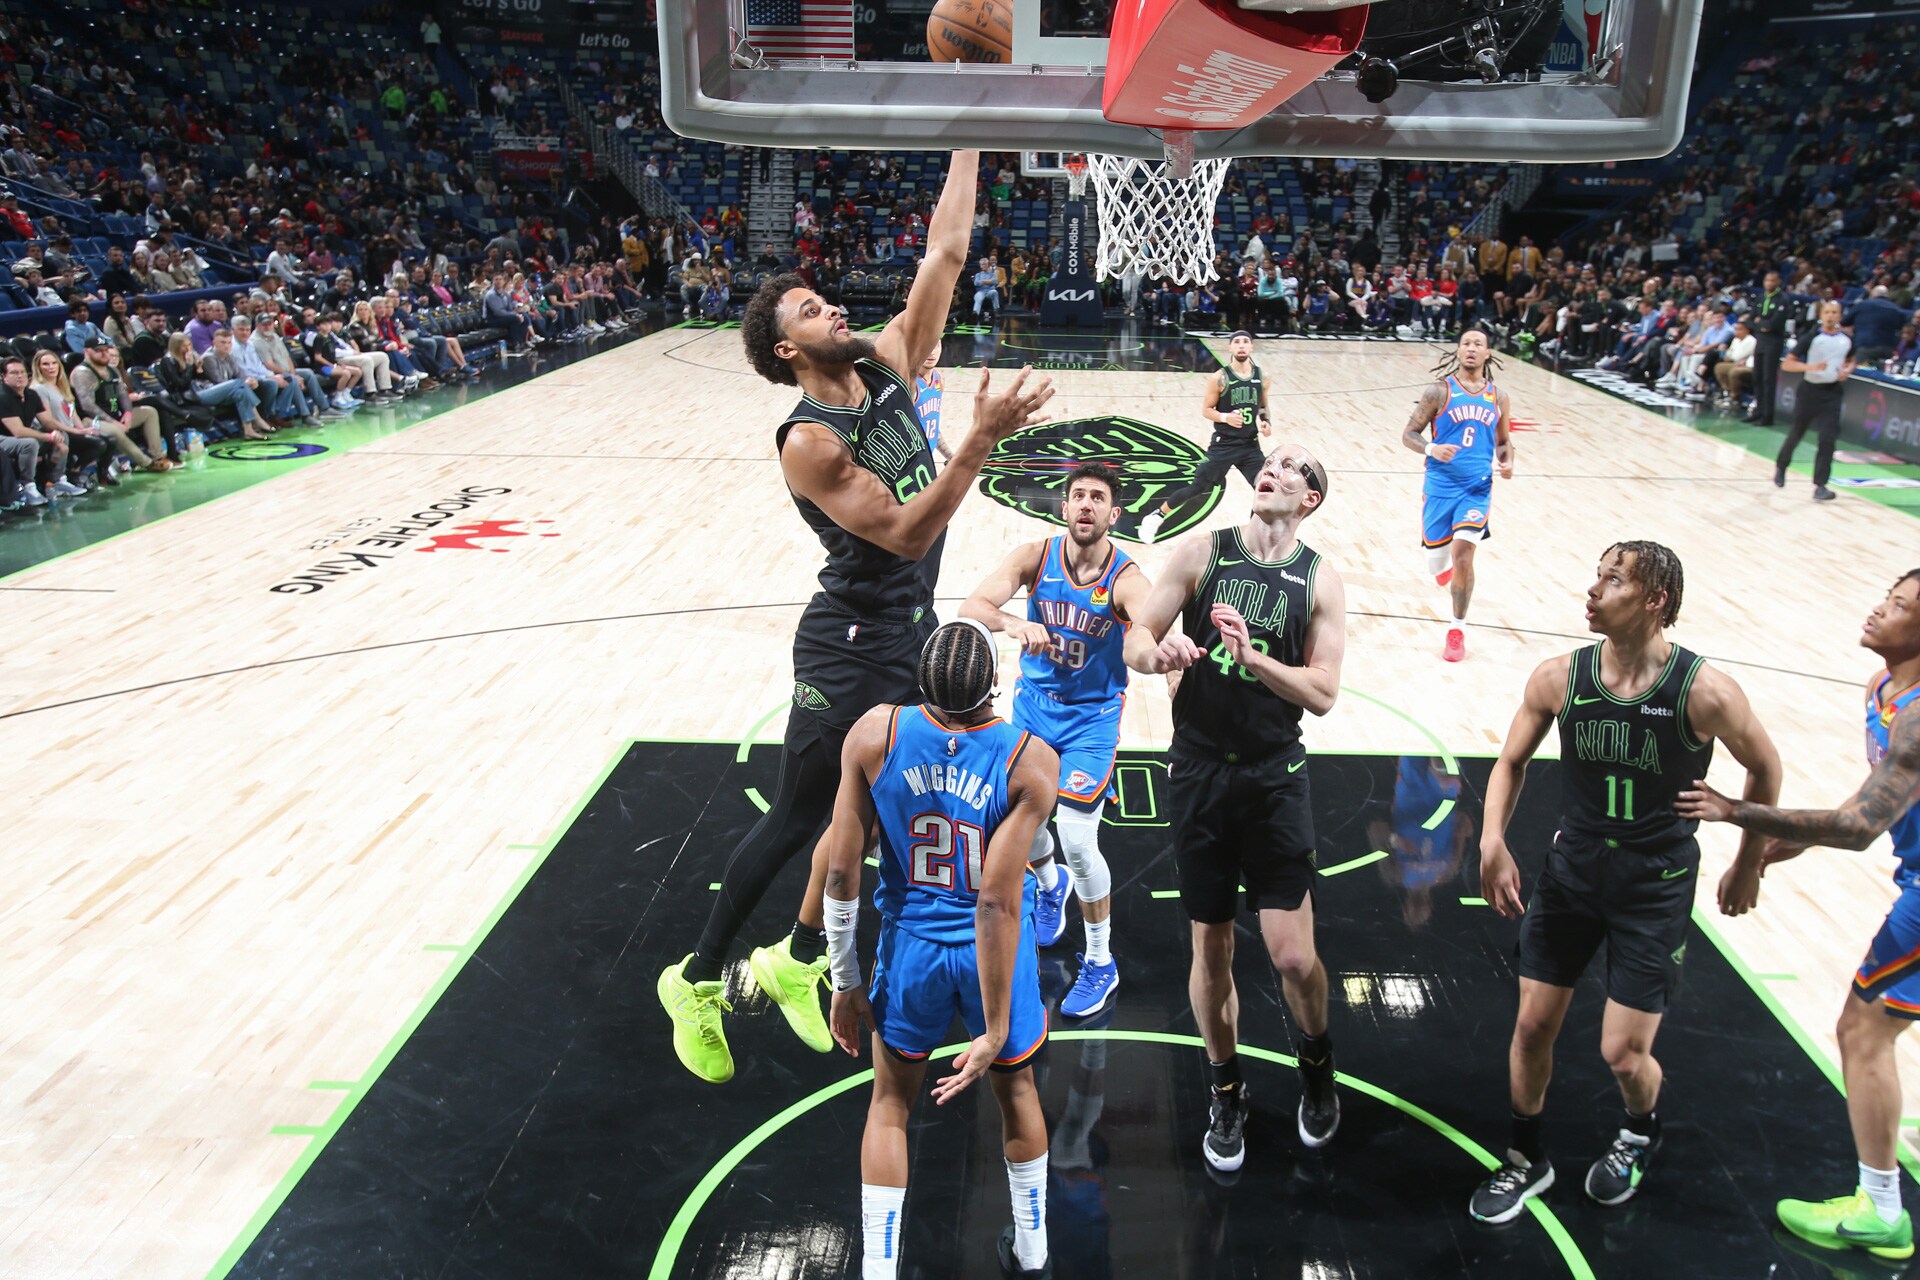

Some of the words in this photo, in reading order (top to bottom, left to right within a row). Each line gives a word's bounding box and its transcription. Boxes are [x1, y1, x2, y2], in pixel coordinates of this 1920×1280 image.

[580, 32, 610, 47] Let's
[612, 34, 630, 48] Go
[1549, 42, 1577, 65] NBA
[1048, 289, 1095, 301] KIA
[873, 383, 898, 406] ibotta
[925, 418, 937, 440] 12
[1447, 404, 1496, 427] THUNDER
[859, 409, 926, 485] NOLA
[1461, 426, 1476, 447] 6
[356, 486, 512, 549] SMOOTHIE
[1280, 569, 1306, 586] ibotta
[1038, 600, 1114, 639] THUNDER
[1213, 579, 1288, 638] NOLA
[1048, 632, 1087, 670] 29
[1640, 704, 1674, 717] ibotta
[1576, 719, 1662, 774] NOLA
[902, 763, 993, 810] WIGGINS
[1605, 775, 1634, 820] 11
[909, 811, 984, 893] 21
